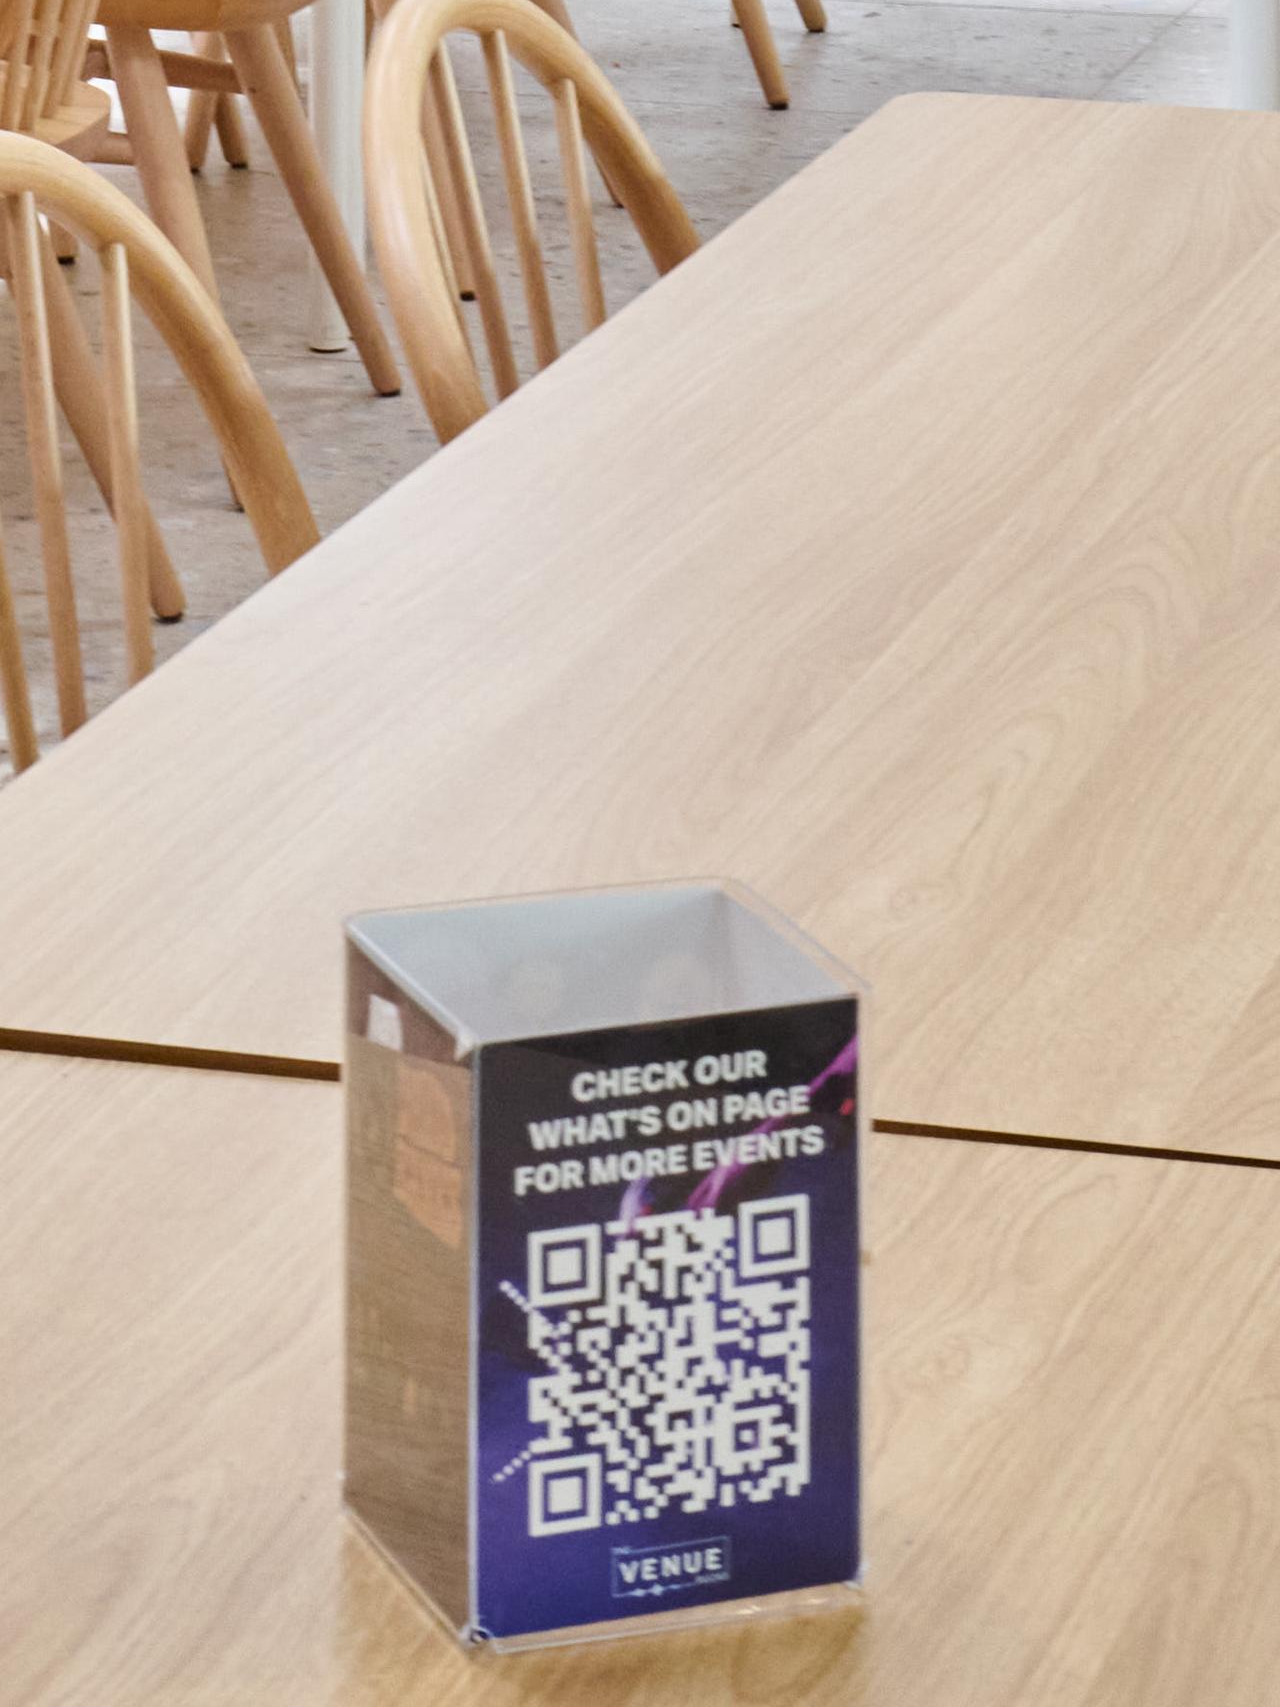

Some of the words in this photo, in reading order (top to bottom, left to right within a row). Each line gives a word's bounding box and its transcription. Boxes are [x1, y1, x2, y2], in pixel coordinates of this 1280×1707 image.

[572, 1059, 689, 1102] CHECK
[693, 1050, 767, 1085] OUR
[528, 1105, 662, 1151] WHAT'S
[666, 1097, 718, 1131] ON
[723, 1085, 811, 1123] PAGE
[514, 1159, 585, 1196] FOR
[588, 1144, 688, 1186] MORE
[692, 1125, 825, 1171] EVENTS
[619, 1547, 722, 1584] VENUE
